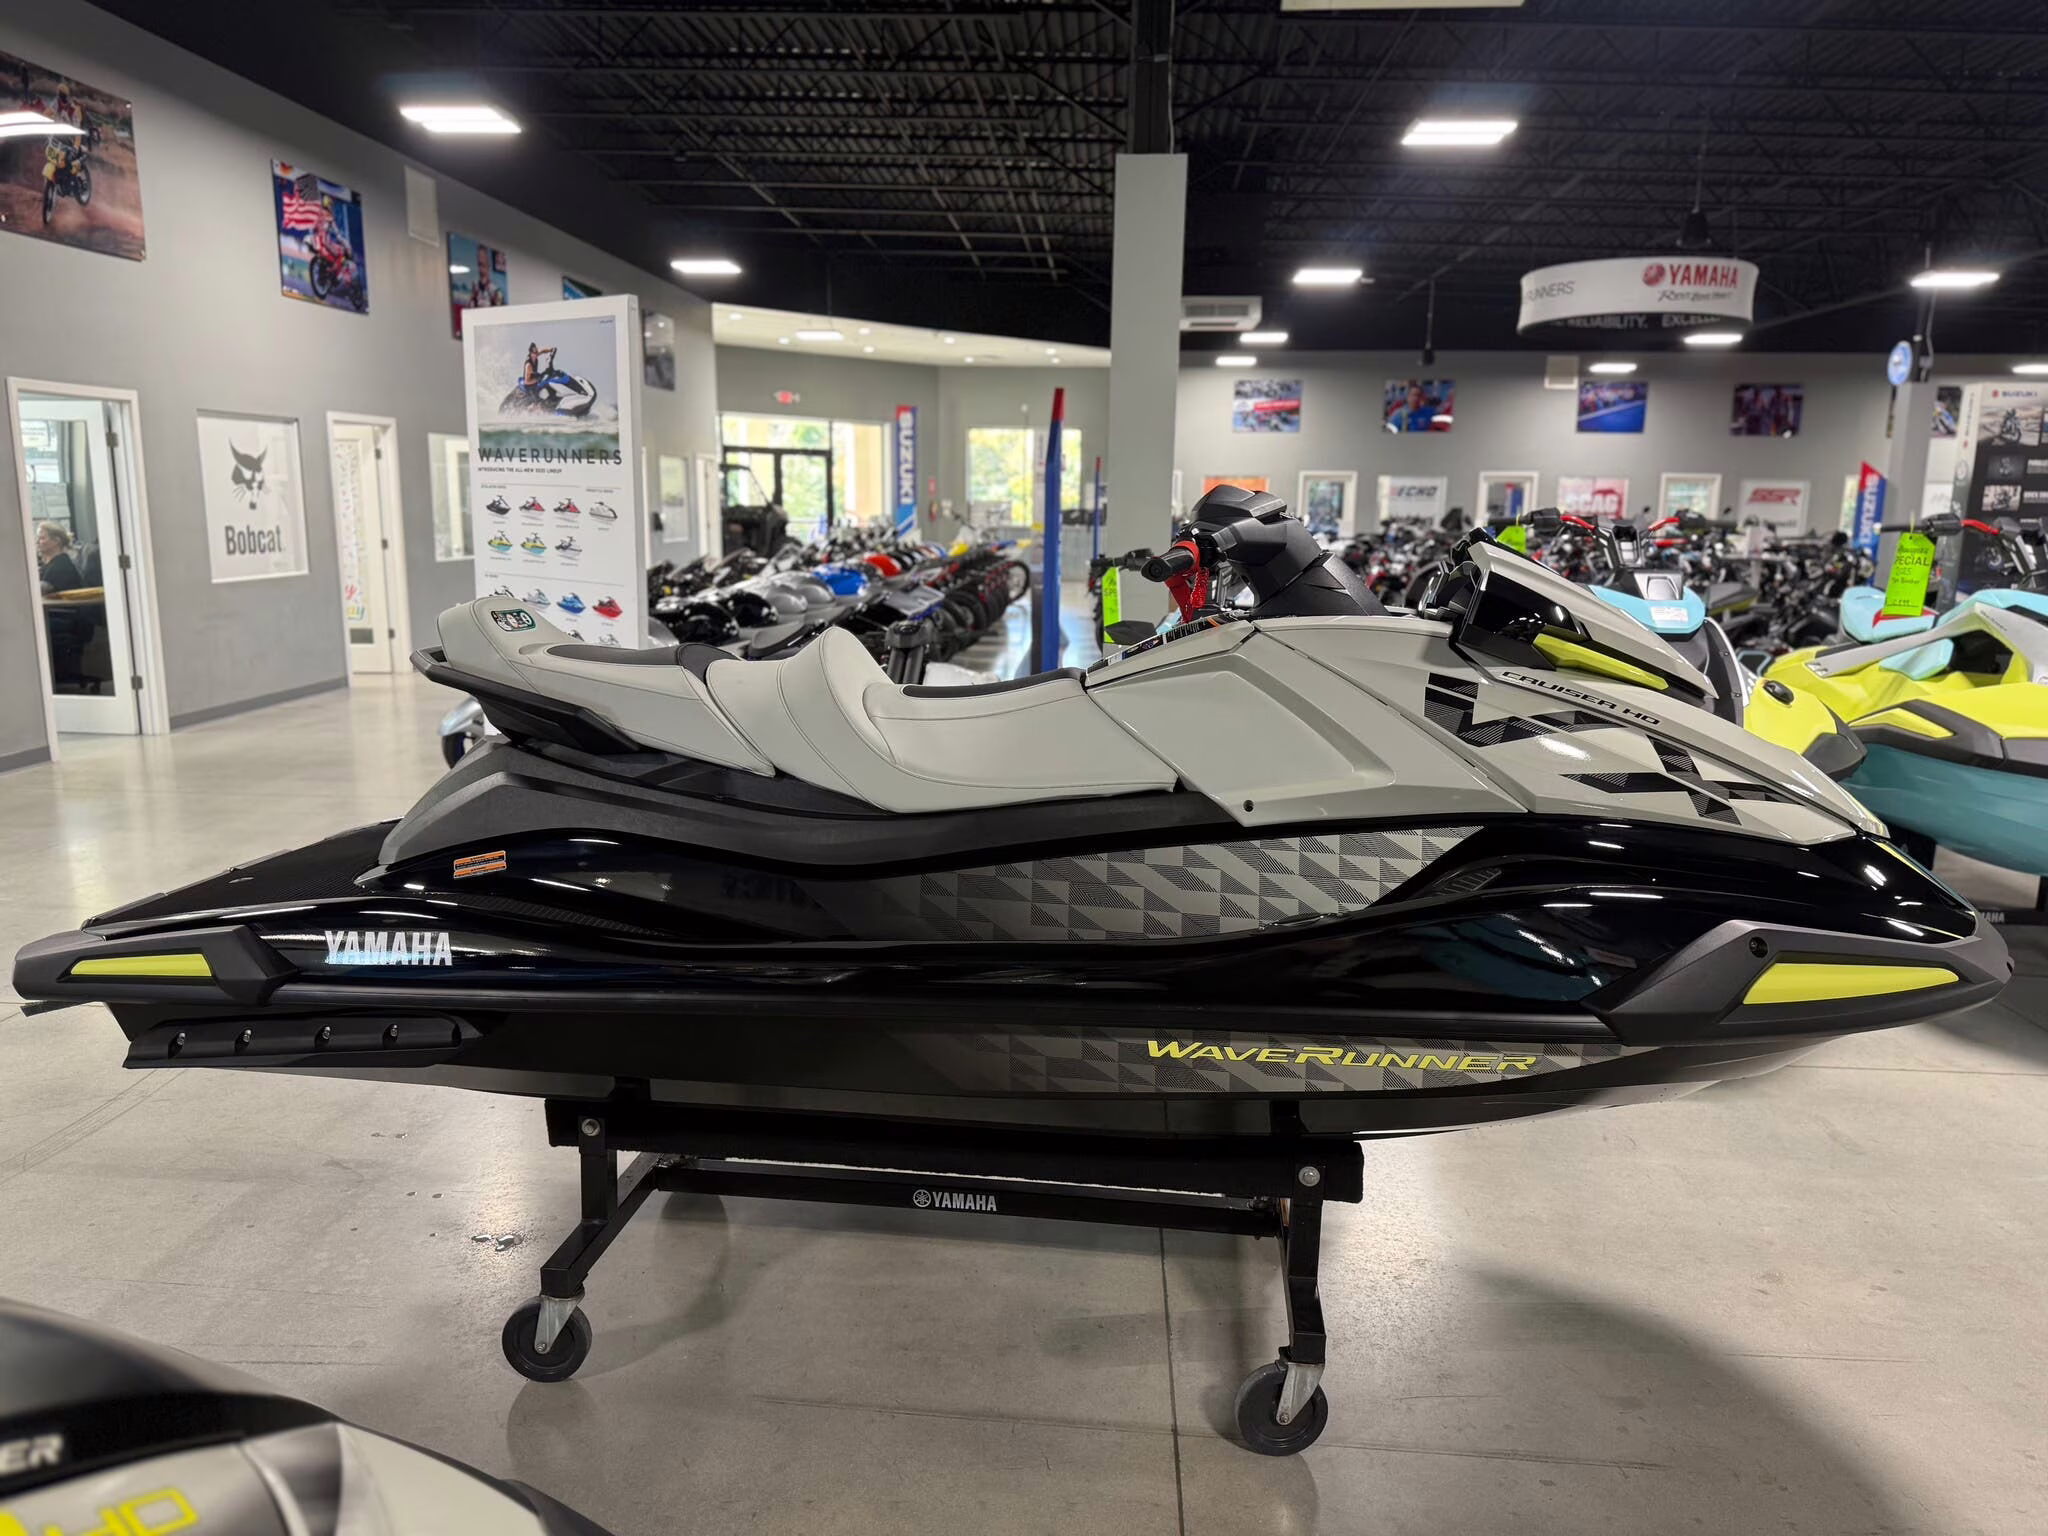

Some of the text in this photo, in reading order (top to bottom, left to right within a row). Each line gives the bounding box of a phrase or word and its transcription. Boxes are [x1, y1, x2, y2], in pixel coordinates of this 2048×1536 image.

[1669, 264, 1738, 288] YAMAHA
[478, 447, 623, 465] WAVERUNNERS
[225, 525, 283, 556] Bobcat
[1502, 671, 1661, 725] CRUISER HO
[324, 930, 453, 966] YAMAHA
[1147, 1040, 1537, 1071] WAVERUNNER
[932, 1191, 997, 1212] YAMAHA
